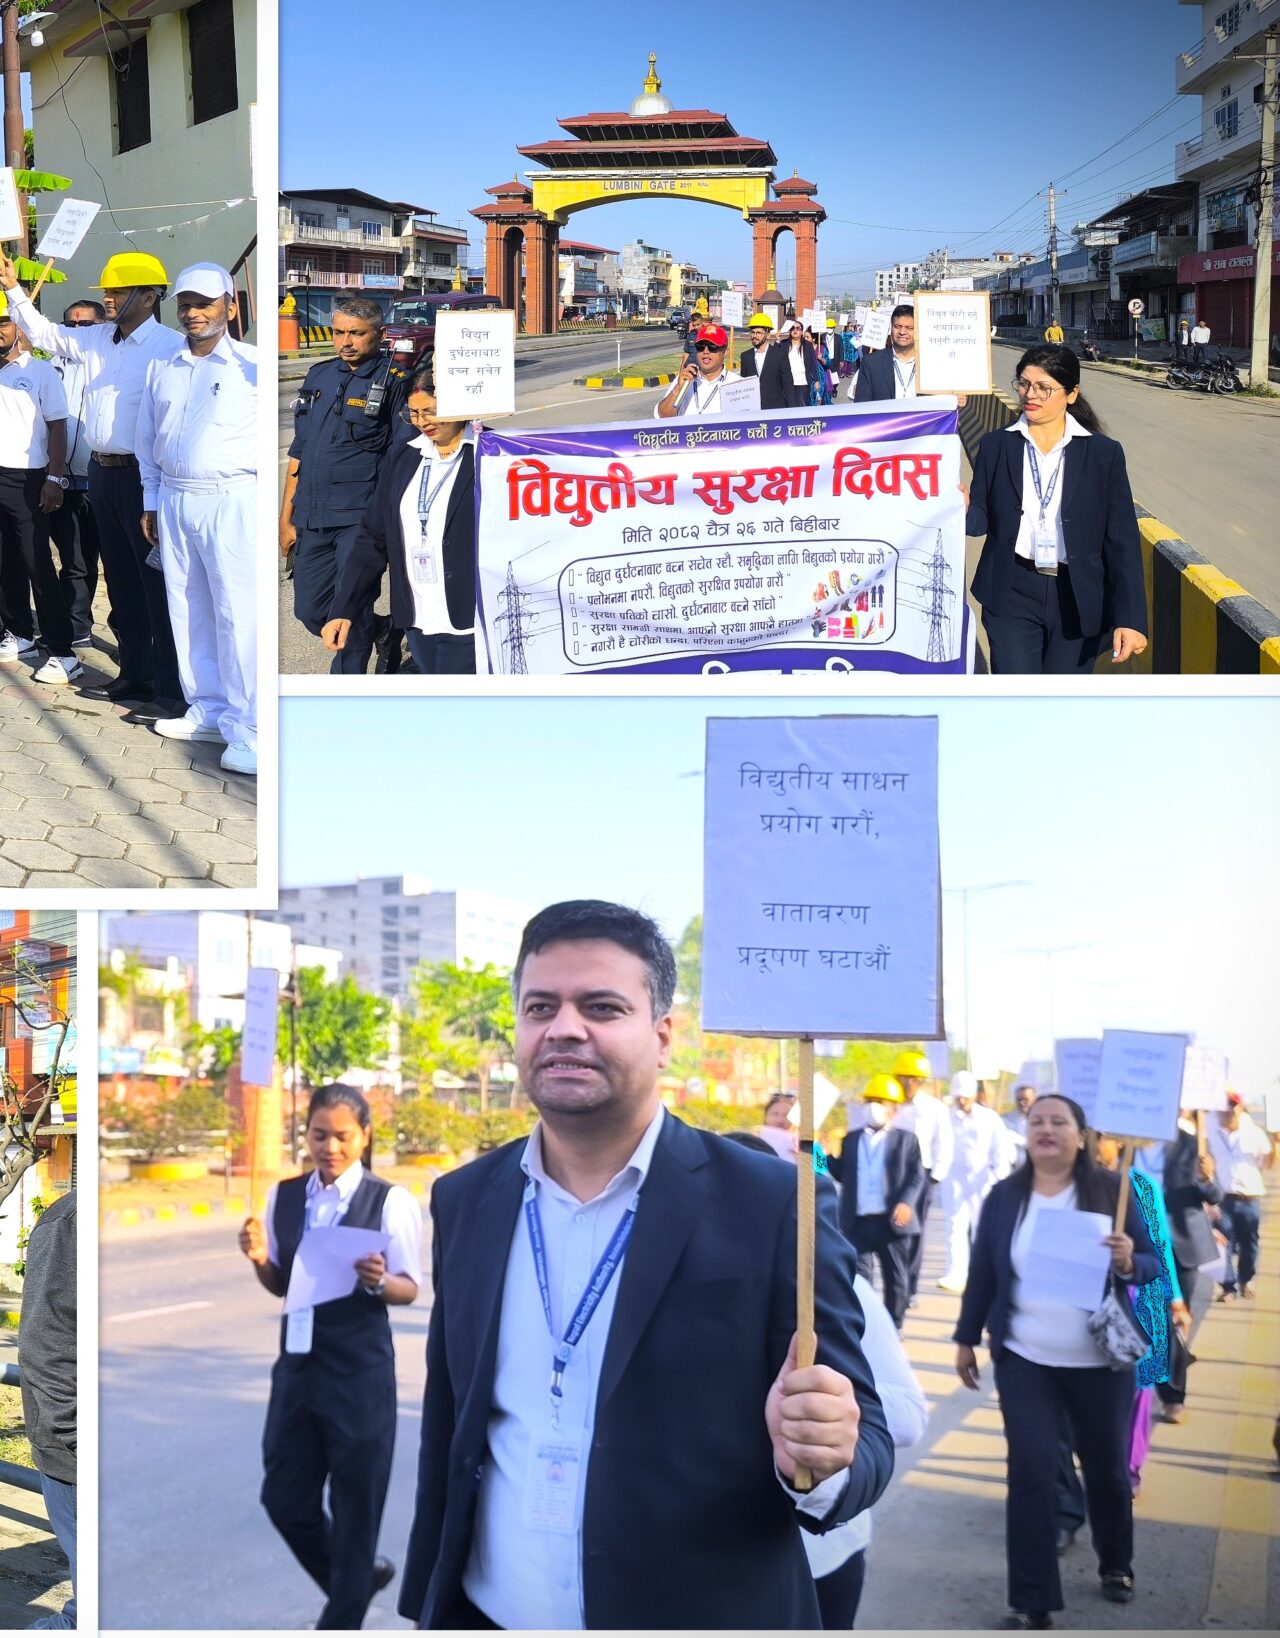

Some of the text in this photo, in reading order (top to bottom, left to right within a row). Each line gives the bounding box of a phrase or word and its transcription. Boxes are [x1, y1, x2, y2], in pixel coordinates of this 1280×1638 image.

[603, 181, 643, 190] LUMBINI
[649, 181, 676, 190] GATE
[506, 446, 943, 527] विद्युतीय सुरक्षा दिवस
[622, 515, 840, 544] मिति २०८२ चैत्र २६ गते बिहीबार
[586, 567, 612, 586] विद्युत
[688, 555, 712, 572] सचेत
[777, 550, 799, 566] लागि
[802, 548, 837, 568] विद्युतको
[659, 579, 694, 600] विद्युतको
[698, 576, 731, 596] सुरक्षित
[734, 574, 764, 590] उपयोग
[589, 610, 616, 620] सुरक्षा
[591, 624, 617, 636] सुरक्षा
[720, 621, 746, 636] सुरक्षा
[738, 761, 910, 796] विद्युतीय साधन
[760, 807, 880, 840] प्रयोग गरौं,
[761, 902, 871, 925] वातावरण
[737, 944, 891, 974] प्रदूषण घटाऔं
